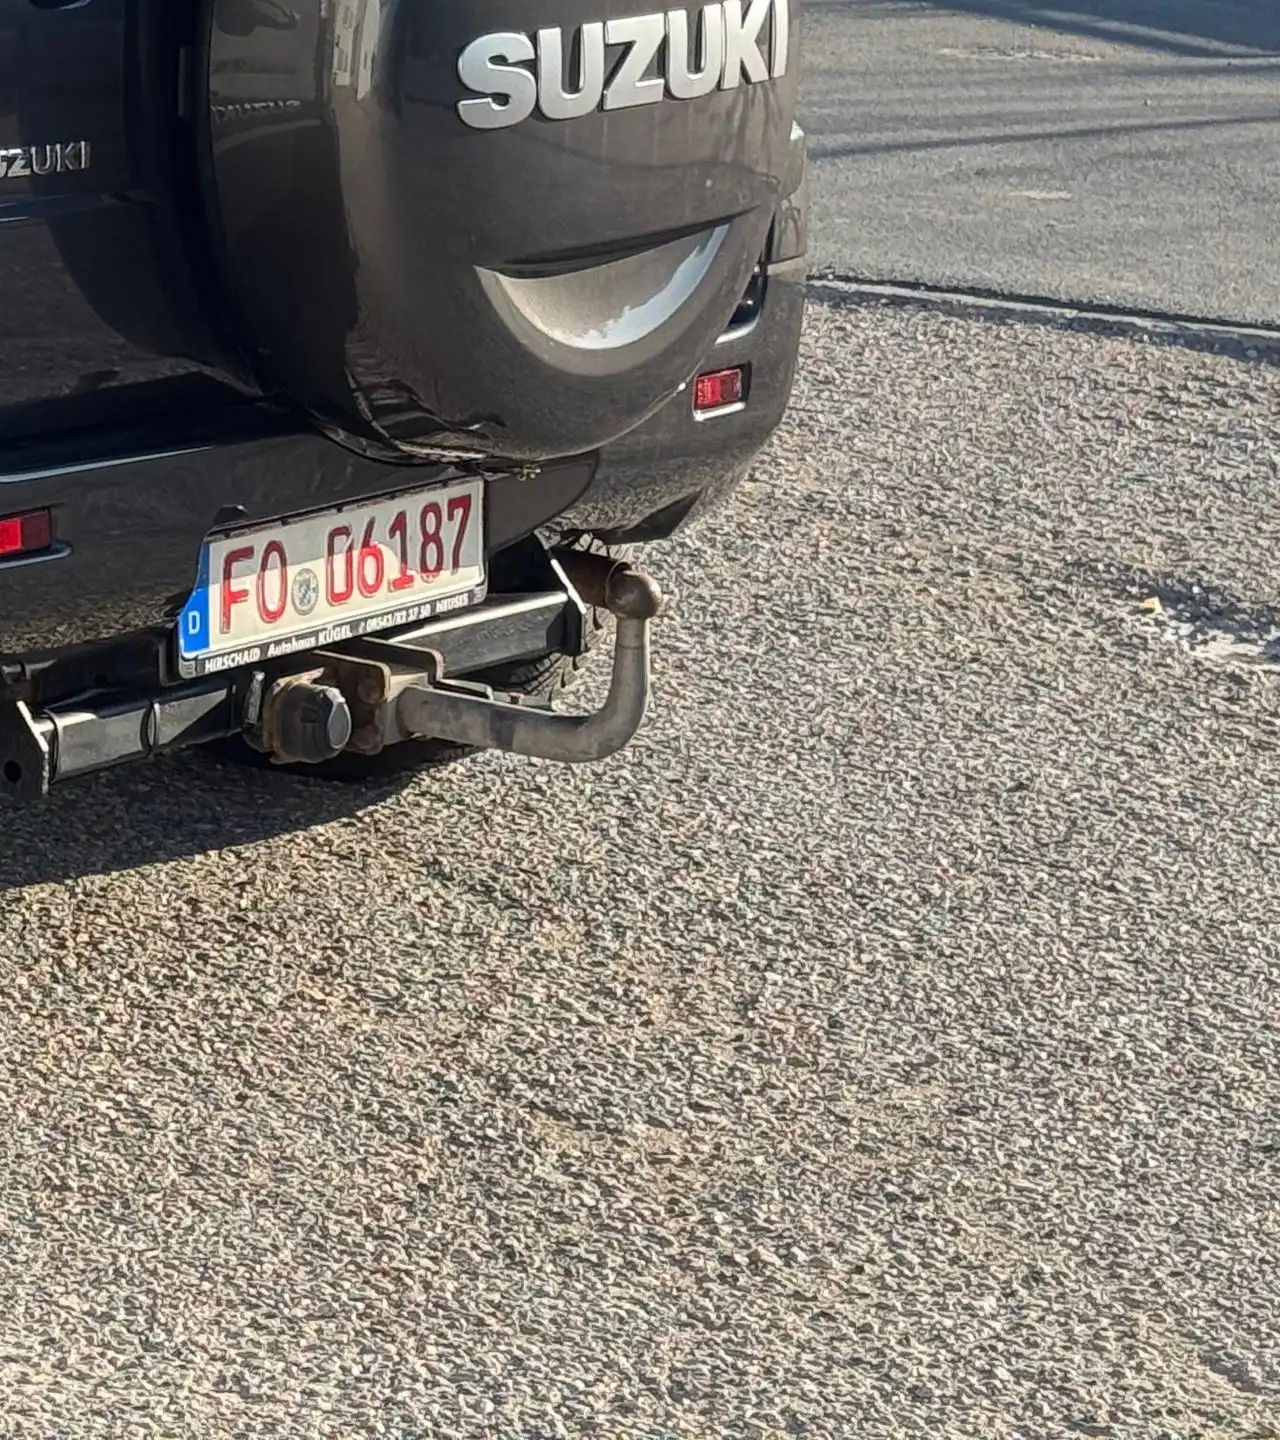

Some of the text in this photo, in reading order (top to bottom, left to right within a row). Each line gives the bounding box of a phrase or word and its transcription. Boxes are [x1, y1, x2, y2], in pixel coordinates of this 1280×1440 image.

[219, 492, 473, 634] FO 06187
[187, 609, 201, 636] D
[267, 635, 317, 657] Autohaus
[318, 623, 353, 647] KÜGEL
